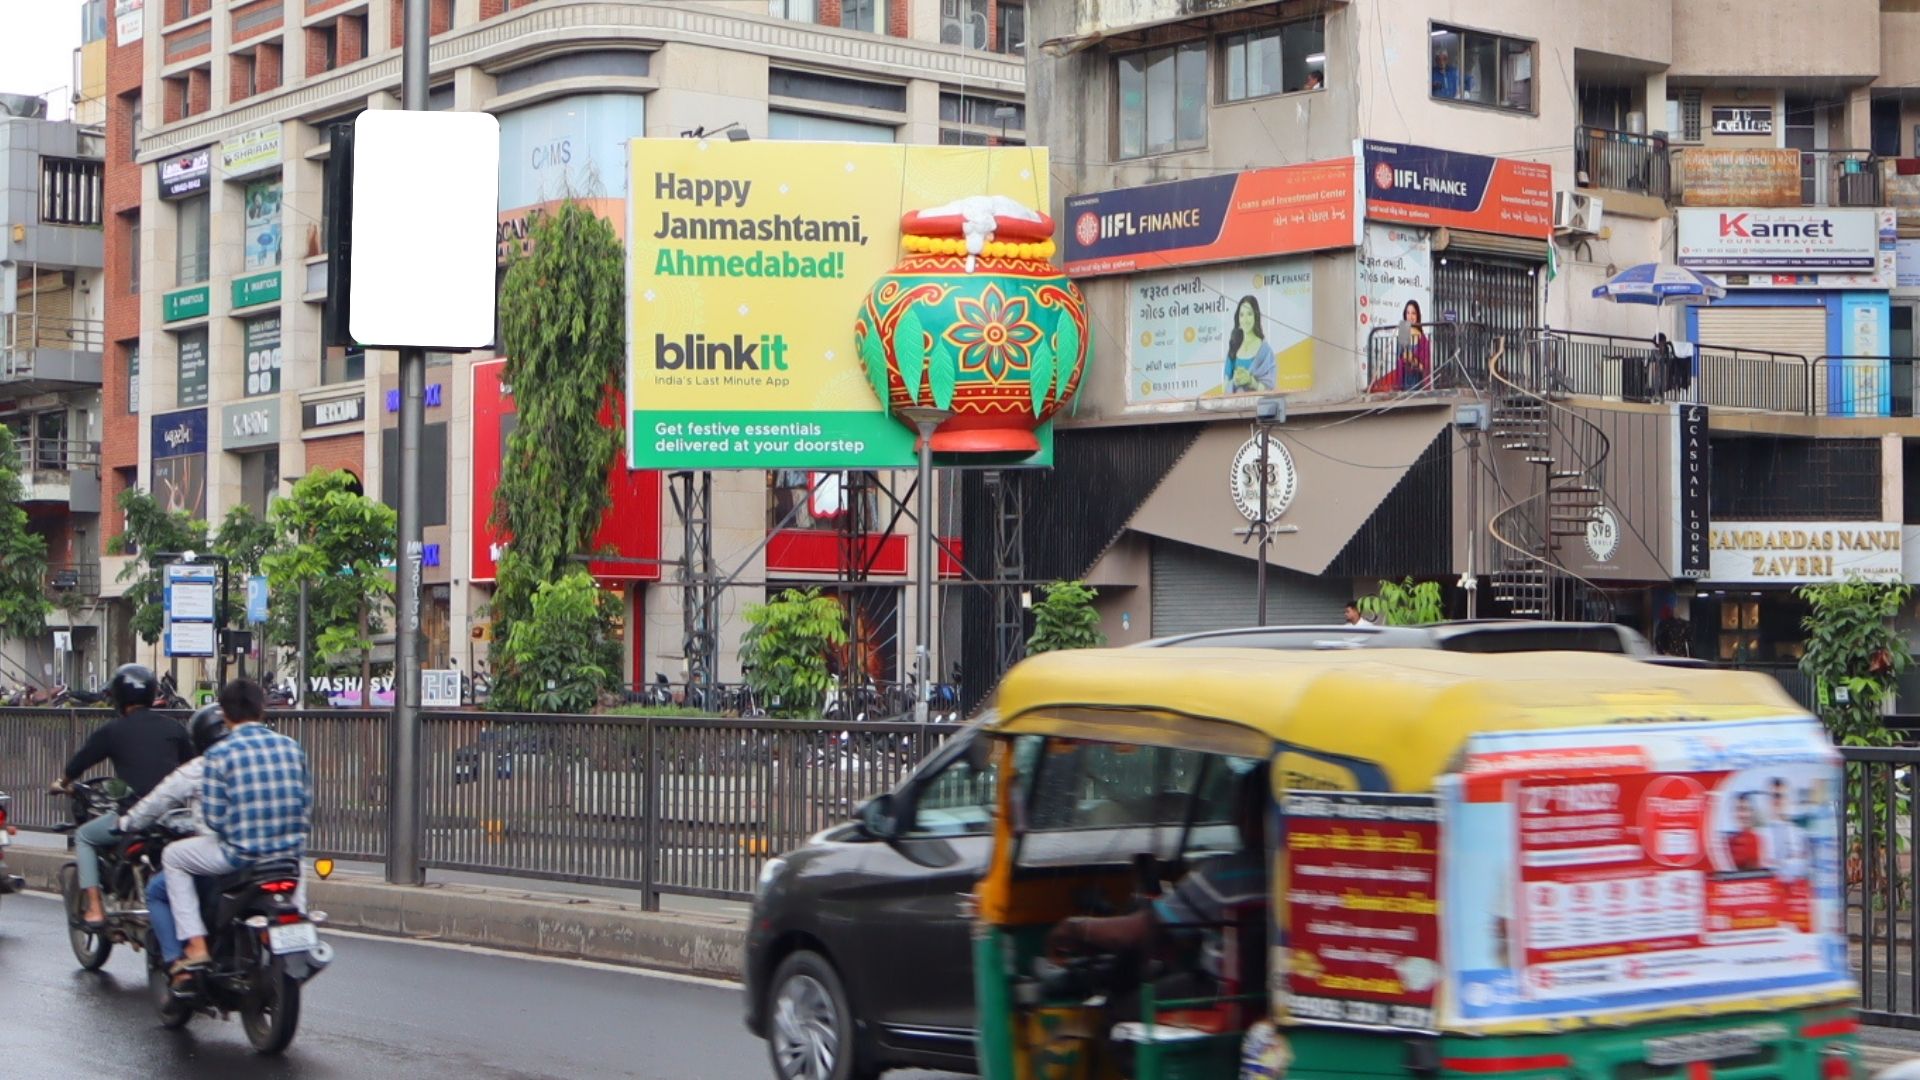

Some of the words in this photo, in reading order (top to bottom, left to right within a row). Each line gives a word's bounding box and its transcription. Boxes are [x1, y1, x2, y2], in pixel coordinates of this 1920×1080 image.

[234, 140, 278, 161] SHRIRAM
[532, 140, 571, 170] CAMS
[654, 172, 751, 207] Happy
[1394, 169, 1421, 190] IIFL
[1423, 177, 1467, 196] FINANCE
[1237, 200, 1259, 210] Loans
[1261, 198, 1276, 206] and
[1277, 192, 1319, 205] Investment
[1320, 189, 1345, 199] Center
[654, 212, 868, 246] Janmashtami,
[1101, 211, 1136, 239] IIFL
[1139, 208, 1200, 234] FINANCE
[1719, 213, 1833, 237] Kamet
[654, 249, 844, 279] Ahmedabad!
[1264, 273, 1280, 286] IIFL
[1282, 273, 1311, 283] FINANCE
[1169, 300, 1189, 318] લોન
[655, 334, 788, 370] blinkit
[655, 376, 692, 386] India's
[695, 376, 720, 386] Last
[723, 376, 762, 386] Minute
[766, 376, 790, 388] App
[655, 423, 682, 436] Get
[685, 423, 740, 436] festive
[744, 423, 821, 436] essentials
[655, 439, 730, 452] delivered
[734, 440, 750, 452] at
[754, 442, 789, 456] your
[794, 439, 864, 455] doorstep
[1689, 425, 1699, 497] CASUAL
[1592, 524, 1611, 538] SVB
[1691, 510, 1699, 564] LOOKS
[1838, 530, 1900, 550] NANJI
[1752, 556, 1833, 576] ZAVERI
